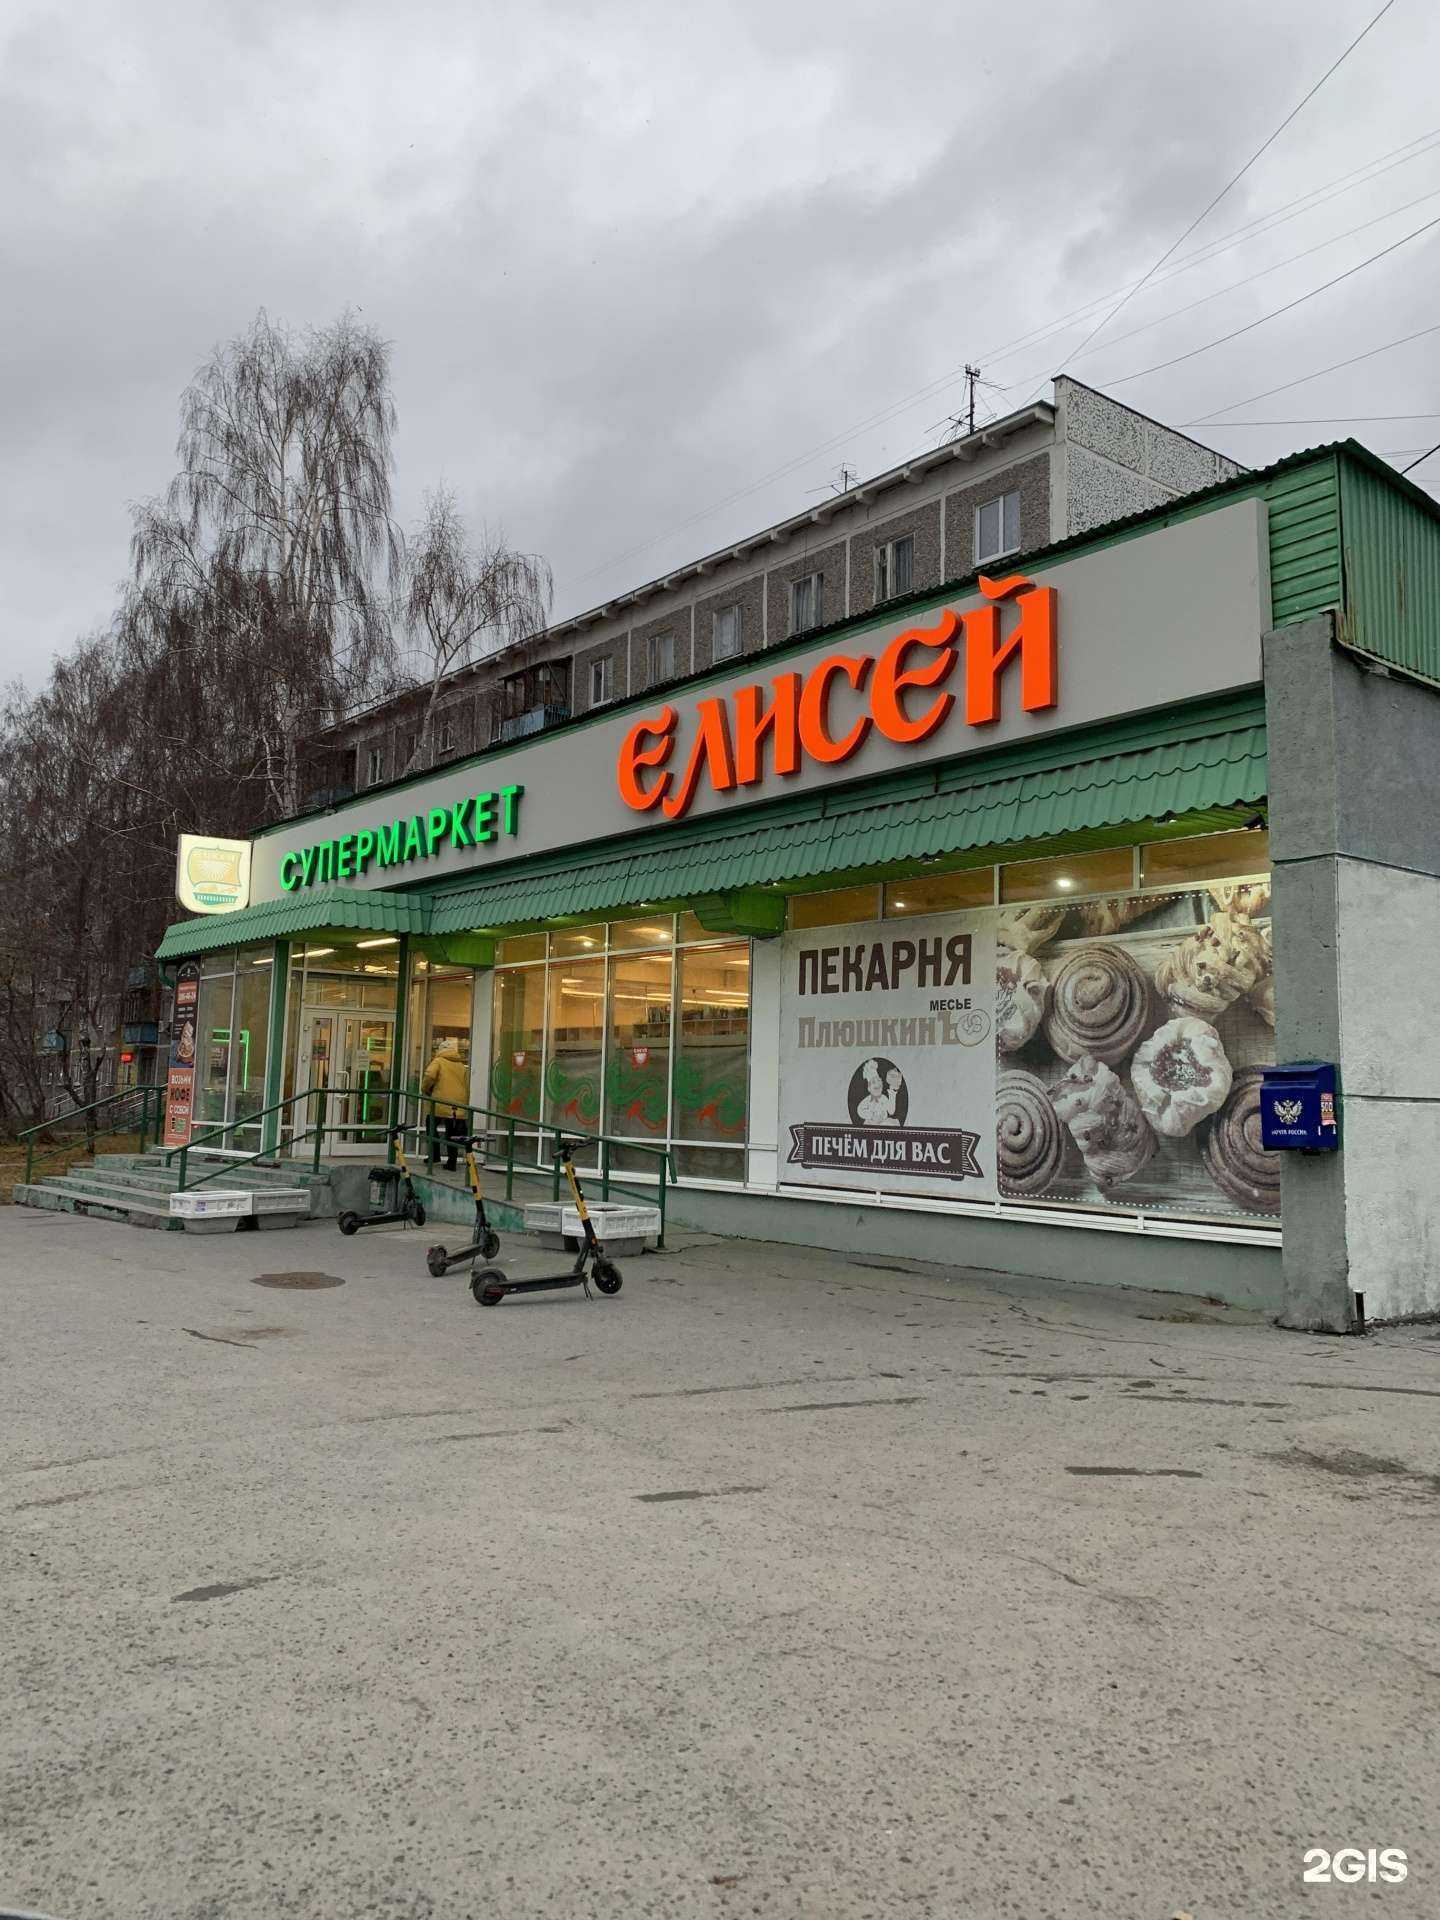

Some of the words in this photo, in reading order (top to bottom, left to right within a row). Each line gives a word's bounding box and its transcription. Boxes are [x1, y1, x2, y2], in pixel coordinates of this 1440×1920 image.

[617, 575, 1057, 819] ЕЛИСЕЙ
[280, 785, 525, 890] СУПЕРМАРКЕТ
[799, 934, 972, 995] ПЕКАРНЯ
[929, 998, 972, 1012] МЕСЬЕ
[811, 1134, 868, 1158] ПЕЧЁМ
[872, 1139, 907, 1163] ДЛЯ
[912, 1141, 951, 1164] ВАС
